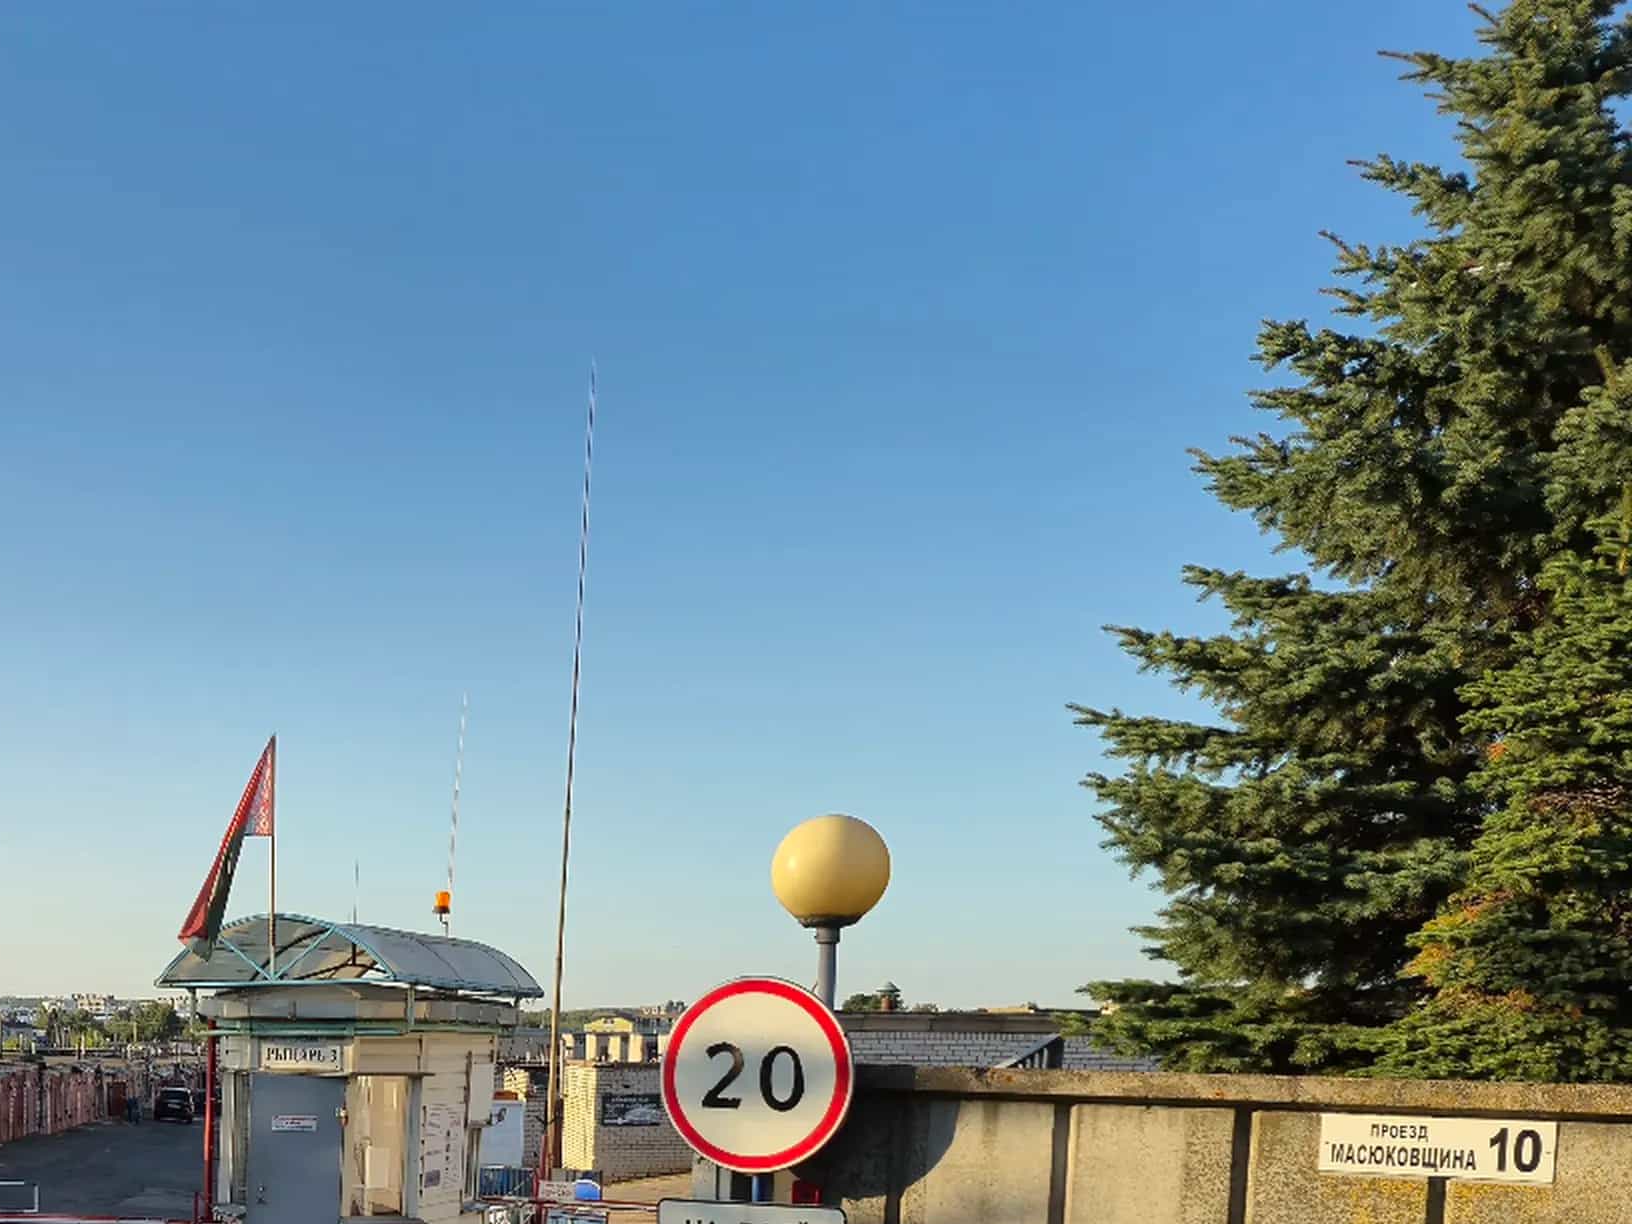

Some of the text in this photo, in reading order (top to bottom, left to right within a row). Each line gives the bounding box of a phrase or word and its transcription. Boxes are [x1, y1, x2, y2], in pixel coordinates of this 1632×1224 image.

[701, 1041, 805, 1112] 20
[1371, 1124, 1429, 1142] ПРОЕЗД
[1489, 1127, 1543, 1173] 10
[1330, 1143, 1477, 1171] МАСЮКОВЩИНА
